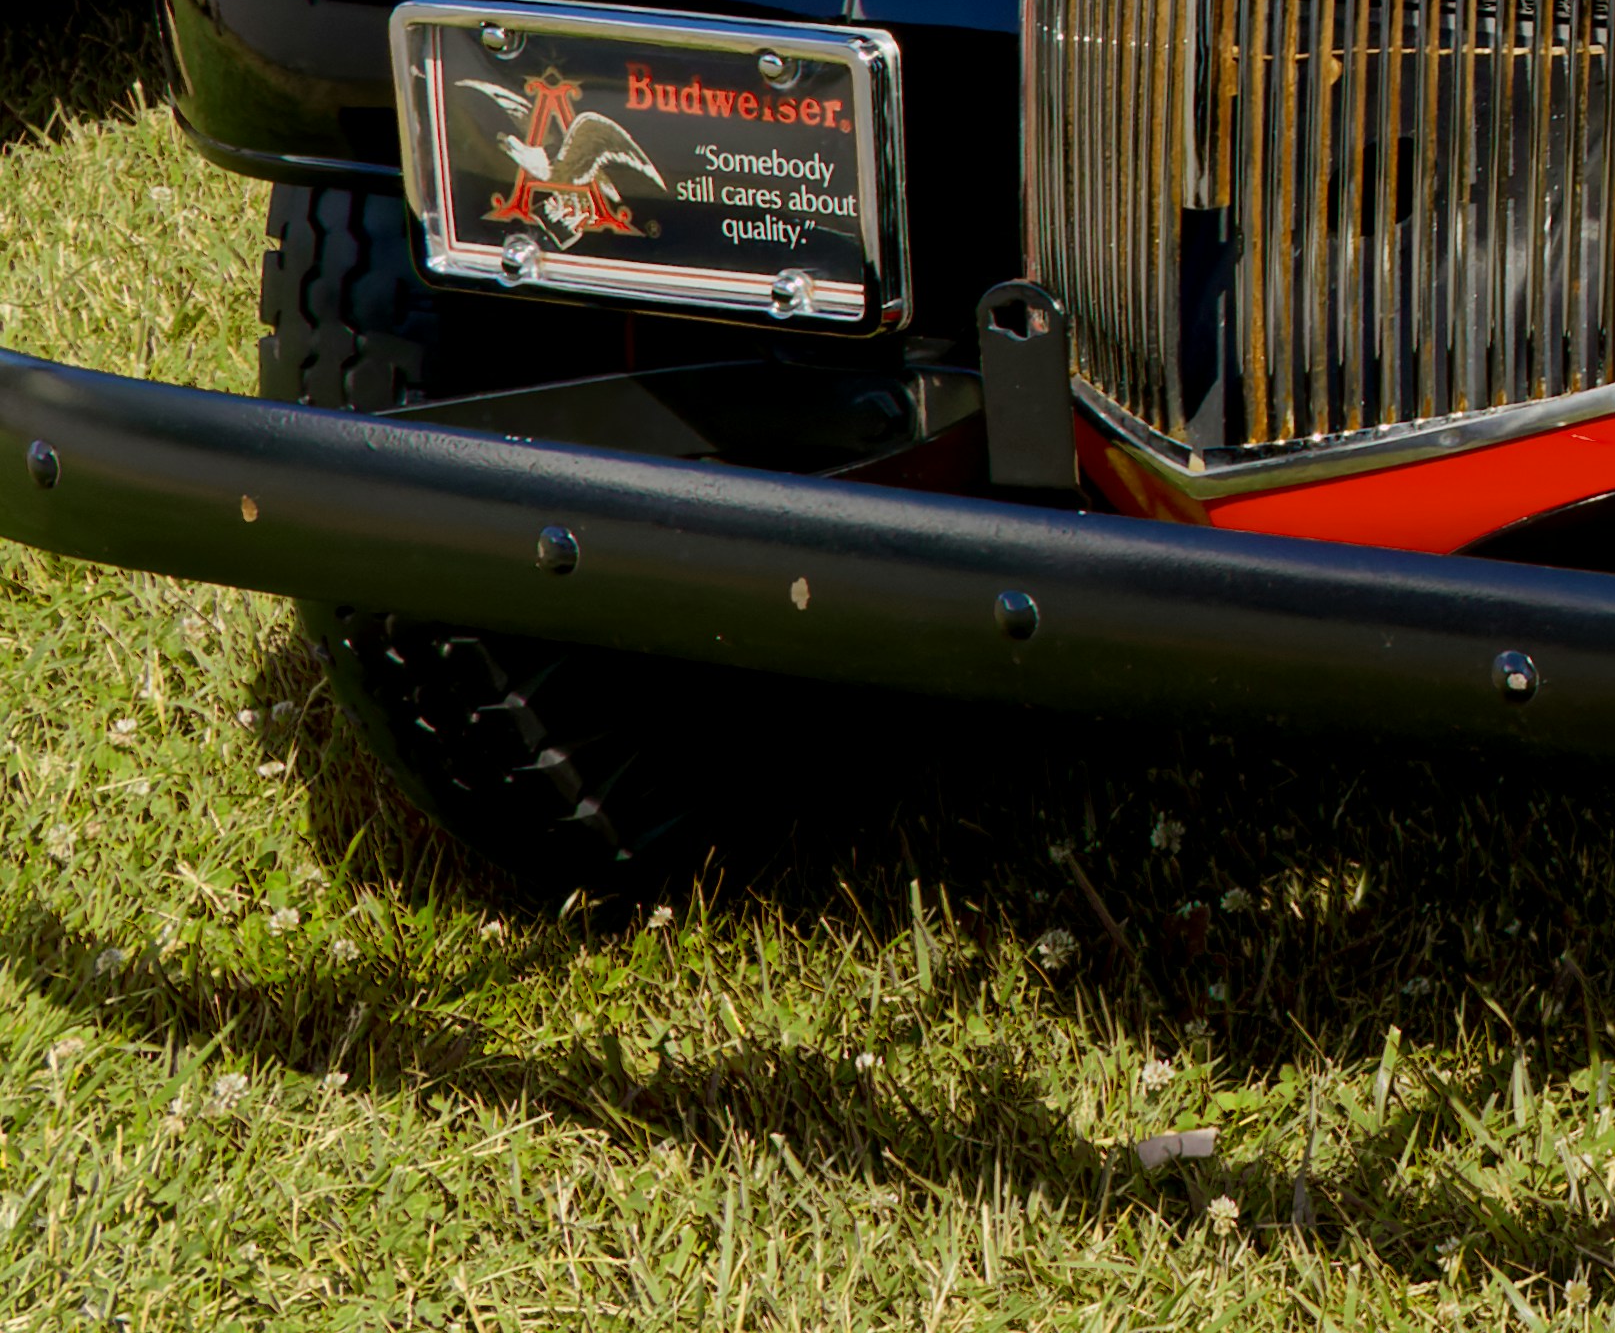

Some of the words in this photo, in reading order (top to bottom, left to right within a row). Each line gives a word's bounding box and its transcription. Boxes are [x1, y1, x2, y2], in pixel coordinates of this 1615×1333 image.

[626, 62, 843, 129] Budweiser
[676, 175, 715, 203] still
[721, 184, 782, 209] cares
[788, 184, 858, 217] about
